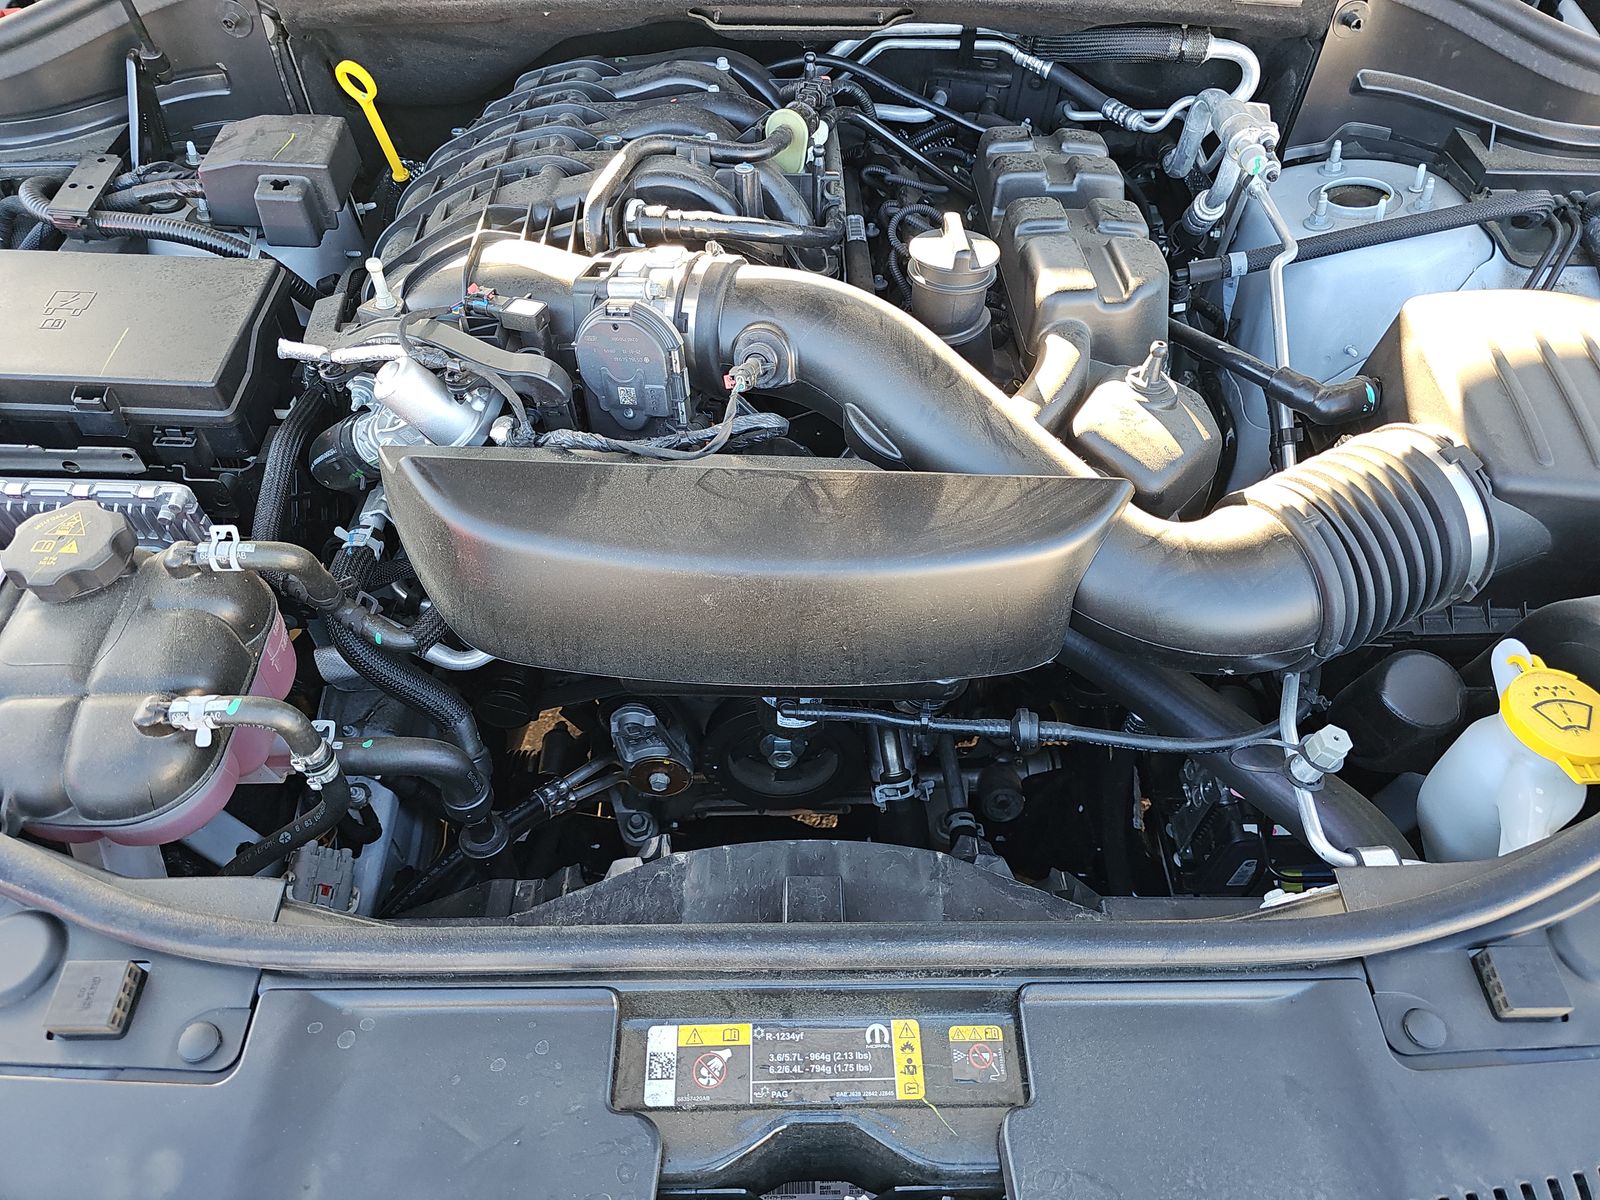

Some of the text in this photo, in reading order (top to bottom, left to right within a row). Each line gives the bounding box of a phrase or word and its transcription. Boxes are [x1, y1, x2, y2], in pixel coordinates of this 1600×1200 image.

[765, 1031, 805, 1042] R-1234yf
[769, 1053, 804, 1062] 3.6/5.7L
[833, 1051, 854, 1062] (2.13
[855, 1051, 872, 1061] lbs)
[769, 1064, 804, 1074] 6.2/6.4L
[833, 1064, 855, 1074] (1.75
[856, 1063, 873, 1073] lbs)
[771, 1090, 789, 1099] PAG
